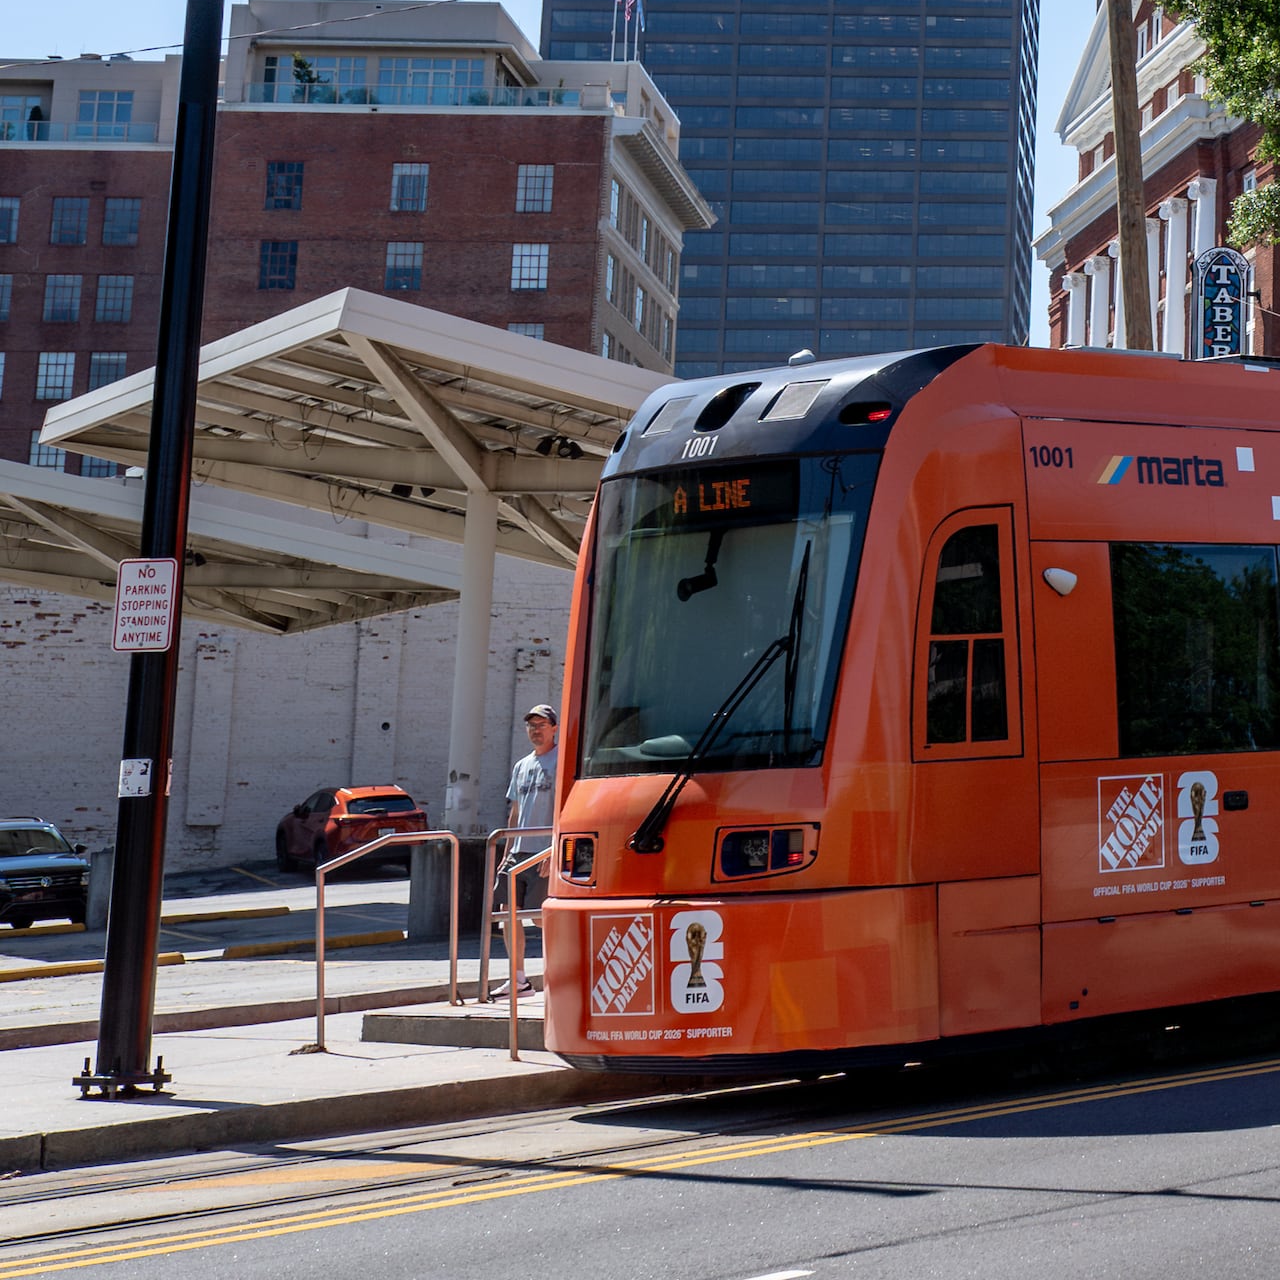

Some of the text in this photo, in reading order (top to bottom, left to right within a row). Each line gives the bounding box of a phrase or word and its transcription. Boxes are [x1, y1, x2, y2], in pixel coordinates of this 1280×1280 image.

[681, 435, 719, 459] 1001
[1029, 445, 1074, 469] 1001
[1136, 455, 1225, 487] marta
[673, 478, 751, 514] A LINE
[138, 568, 156, 579] NO
[125, 584, 167, 595] PARKING
[121, 600, 168, 611] STOPPING
[120, 615, 167, 627] STANDING
[121, 631, 162, 642] ANYTIME
[1106, 786, 1133, 825] THE
[1100, 775, 1163, 869] HOME
[1125, 808, 1163, 868] DEPOT
[1190, 845, 1209, 857] FIFA
[1093, 886, 1121, 897] OFFICIAL
[1121, 885, 1136, 894] FIFA
[1137, 882, 1159, 893] WORLD
[1159, 881, 1172, 890] CUP
[1191, 875, 1225, 888] SUPPORTER
[596, 926, 621, 967] THE
[592, 915, 653, 1014] HOME
[612, 951, 653, 1013] DEPOT
[685, 992, 710, 1004] FIFA
[586, 1030, 610, 1041] OFFICIAL
[610, 1031, 623, 1040] FIFA
[624, 1030, 647, 1041] WORLD
[648, 1030, 662, 1040] CUP
[687, 1026, 733, 1039] SUPPORTER
